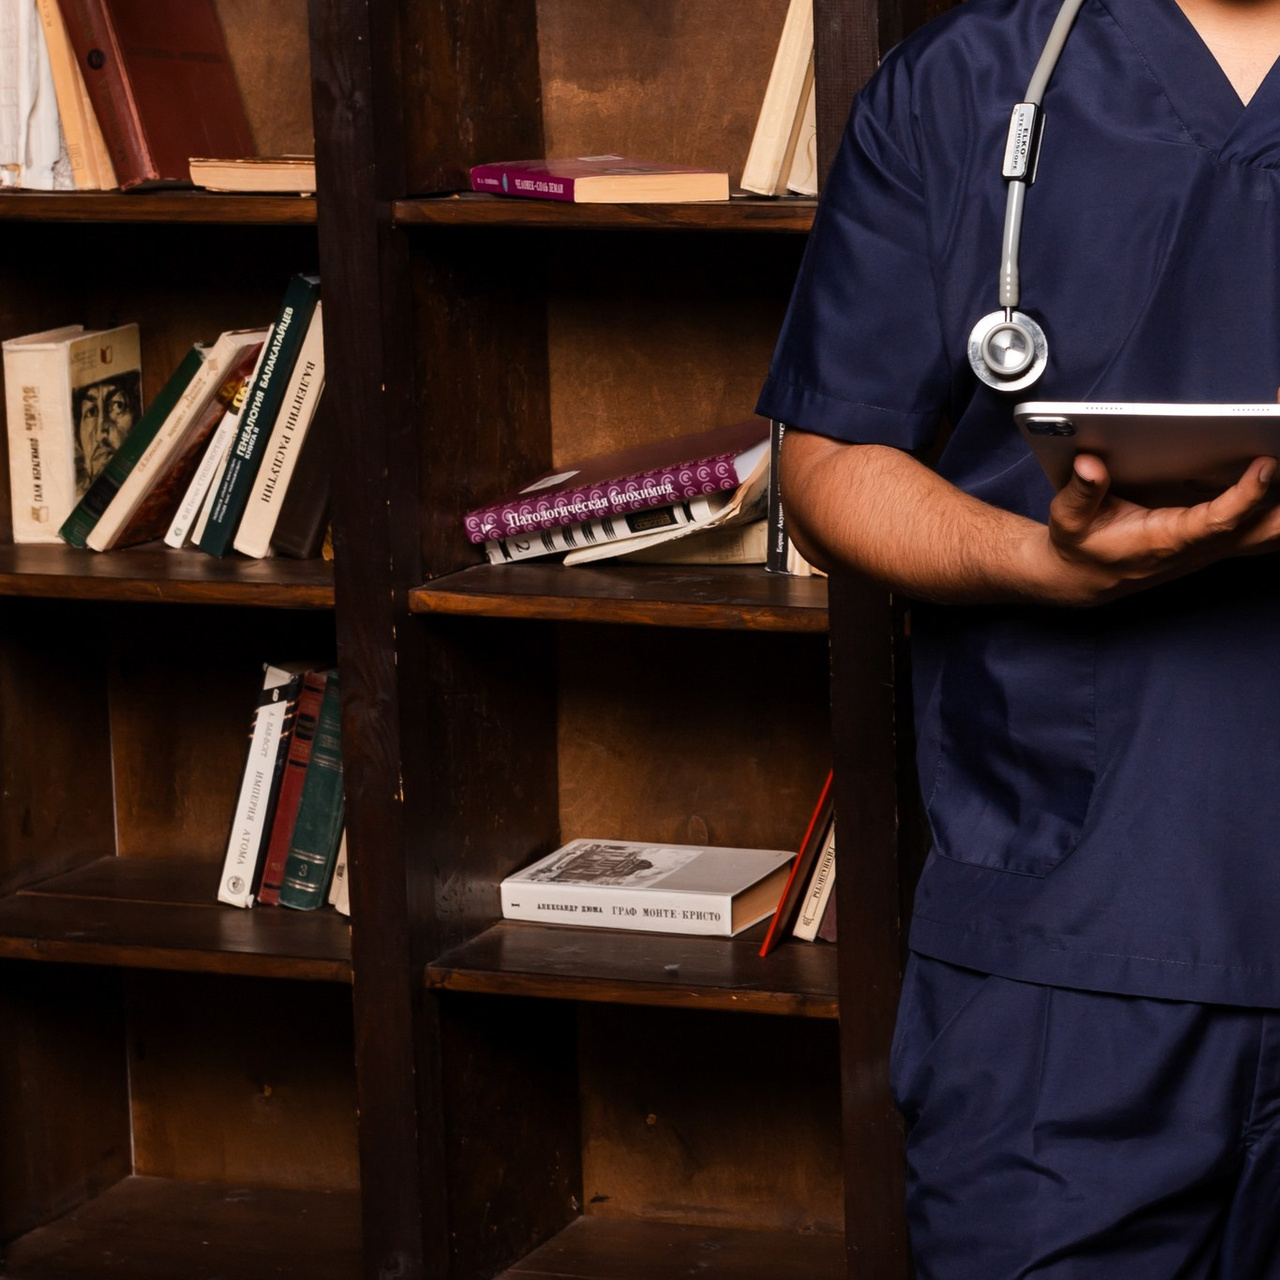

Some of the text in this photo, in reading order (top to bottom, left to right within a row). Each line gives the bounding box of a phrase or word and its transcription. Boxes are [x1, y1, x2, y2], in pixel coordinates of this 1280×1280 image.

[1010, 111, 1025, 170] STETHOSCOPE
[1018, 127, 1030, 155] ELKO
[232, 389, 268, 457] ГЕНЕАЛОГИЯ
[255, 305, 298, 390] БАЛАКАТАЙЦЕВ
[242, 434, 258, 460] КНИГА
[258, 358, 316, 505] ВАЛЕНТИН РАСПУТИН
[29, 436, 43, 501] ГАЛИ ИБРАГИМОВ
[507, 492, 610, 531] Патологическая
[608, 478, 674, 508] биохимия
[776, 531, 784, 551] Борис
[271, 687, 279, 702] 6
[235, 769, 264, 866] ИМПЕРИЯ АТОМА
[537, 904, 603, 914] АЛЕКСАНДР ДЮМА
[612, 906, 638, 916] ГРАФ
